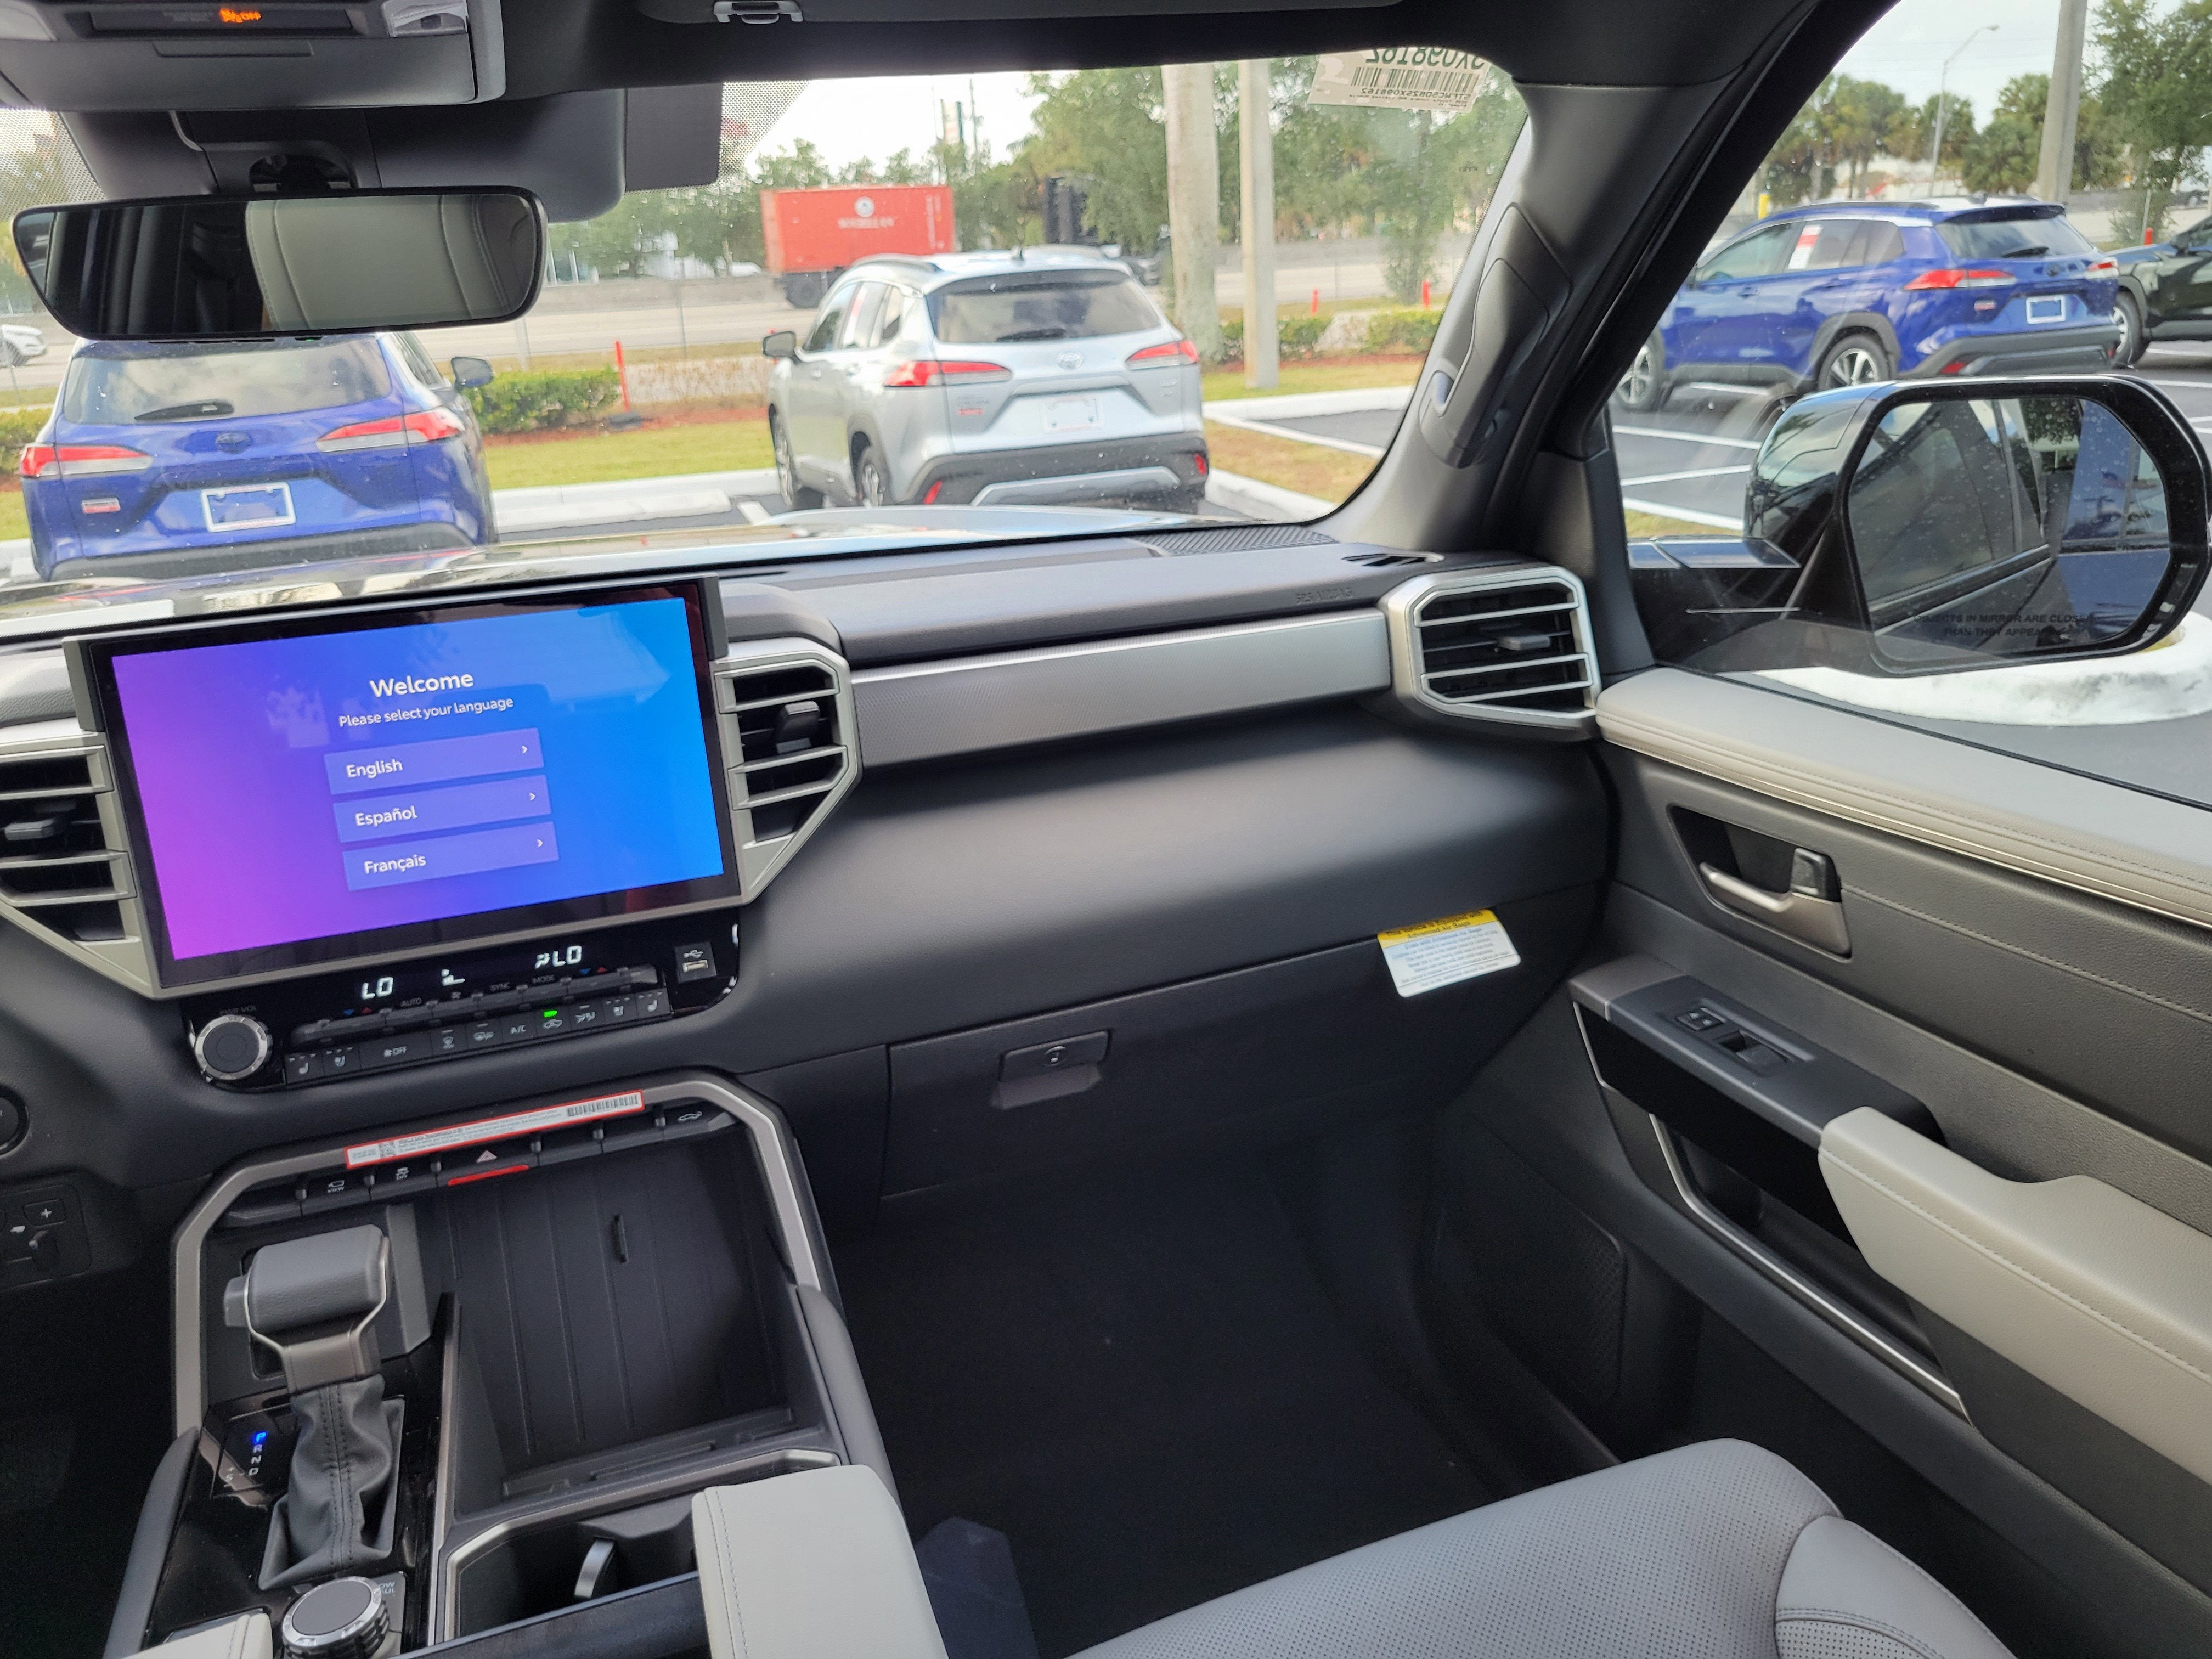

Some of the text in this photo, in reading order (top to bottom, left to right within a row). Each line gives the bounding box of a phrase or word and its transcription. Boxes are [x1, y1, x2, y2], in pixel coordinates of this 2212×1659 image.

[2024, 614, 2046, 622] ARE
[2005, 627, 2044, 636] APPEA
[370, 673, 473, 697] Welcome
[339, 696, 514, 727] Please select your language
[346, 759, 403, 779] English
[355, 805, 417, 827] Español
[364, 854, 426, 874] Français
[532, 974, 555, 984] MODE
[490, 981, 511, 991] SYNC
[401, 998, 422, 1008] AUTO
[510, 1024, 526, 1035] A/C
[392, 1046, 408, 1056] OFF
[256, 1432, 267, 1443] P
[253, 1444, 263, 1453] R
[251, 1455, 262, 1464] N
[249, 1467, 259, 1476] D
